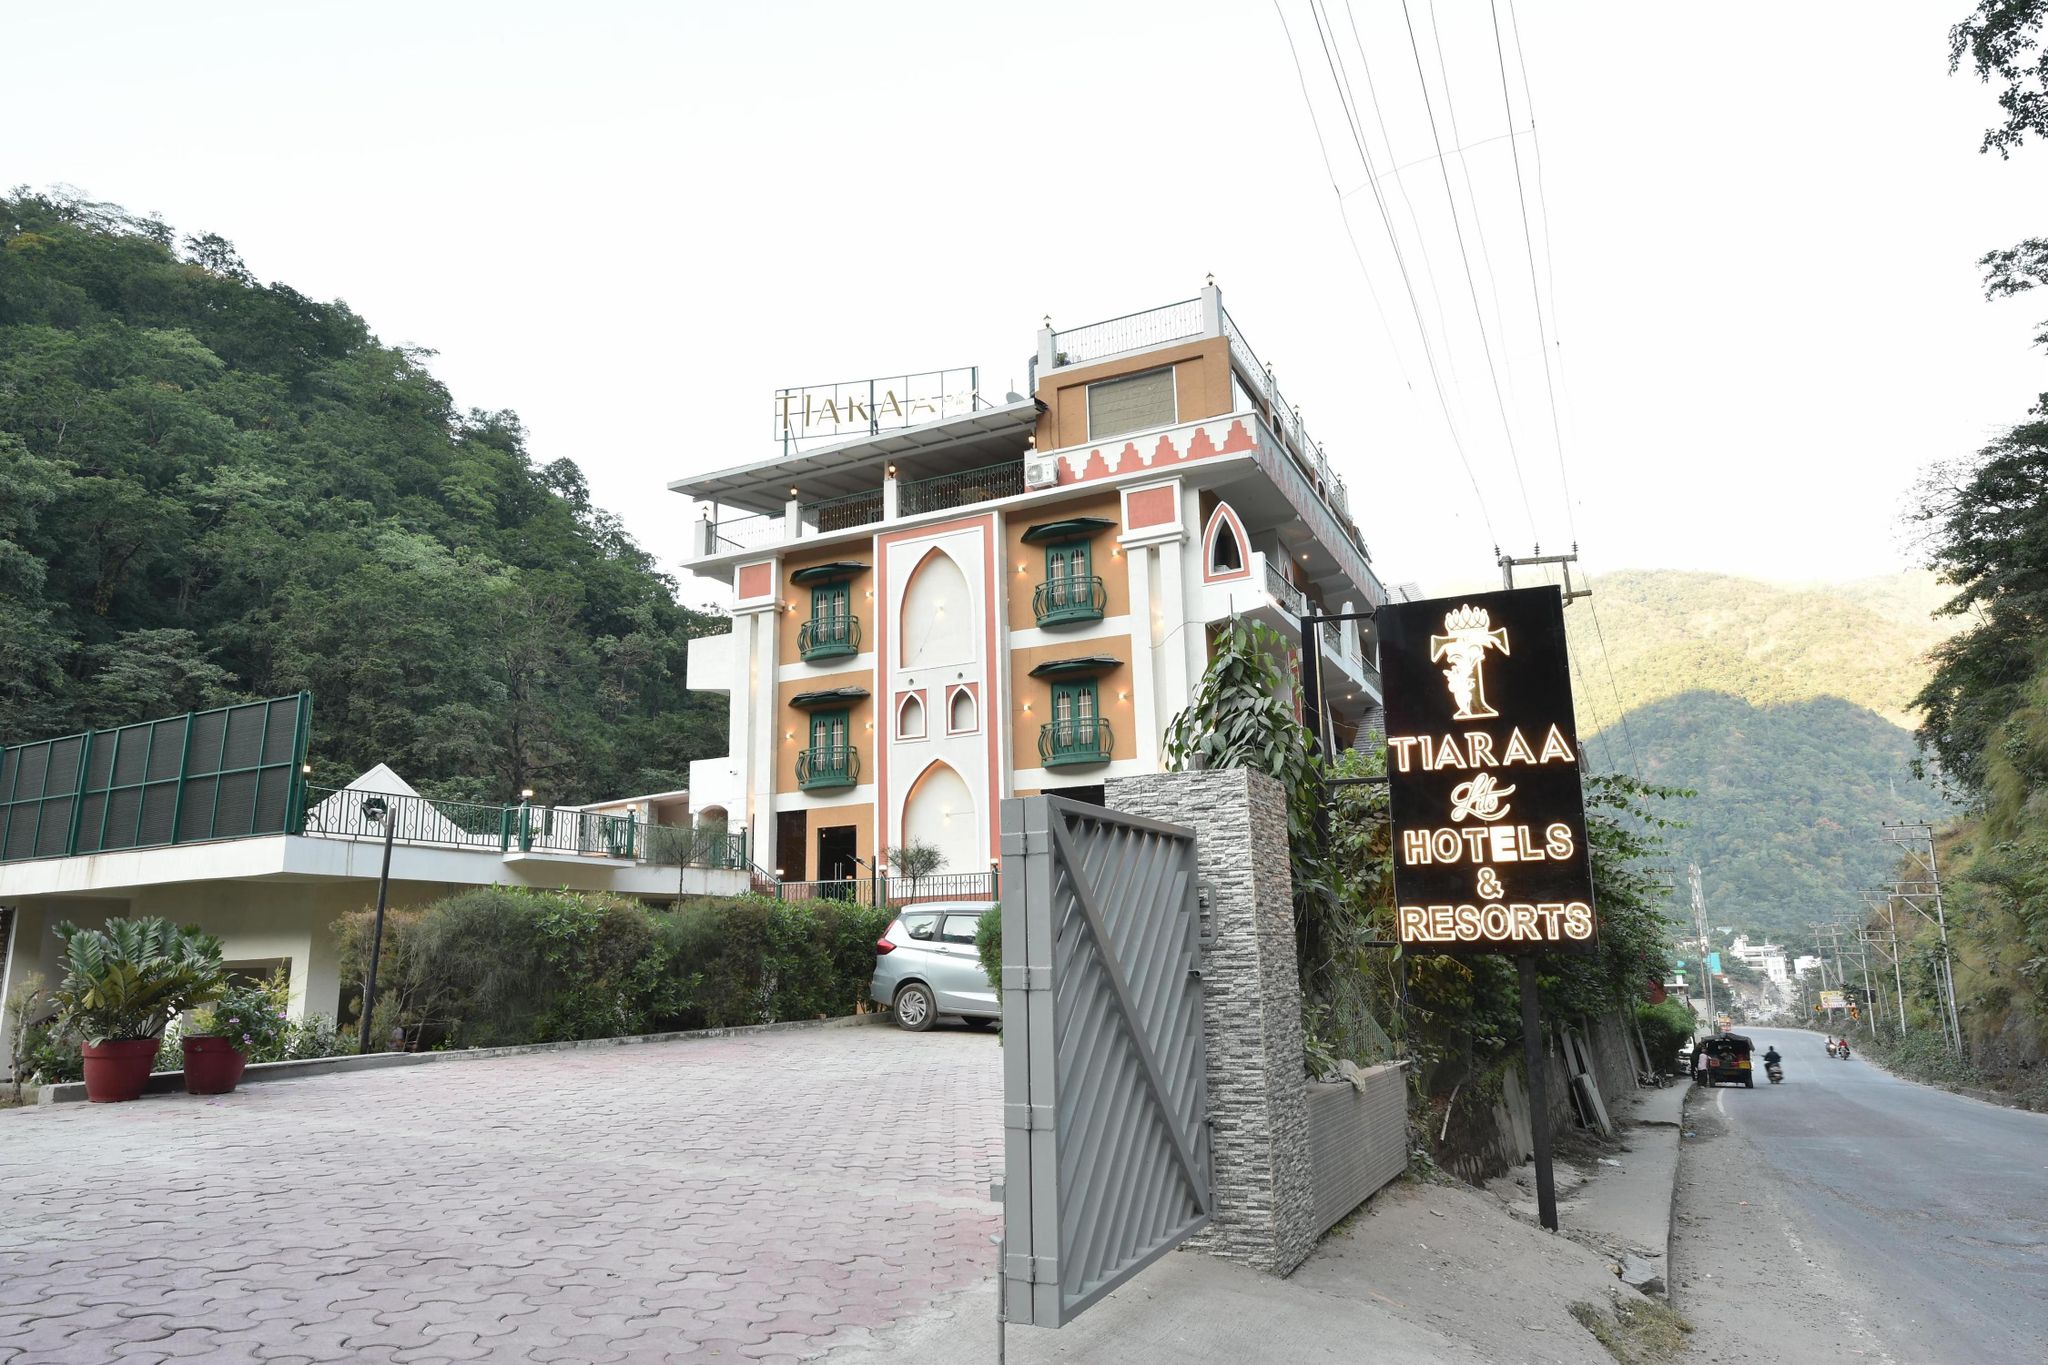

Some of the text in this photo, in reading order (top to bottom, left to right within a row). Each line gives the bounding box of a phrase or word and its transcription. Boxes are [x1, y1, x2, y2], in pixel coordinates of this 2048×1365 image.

[1388, 723, 1575, 772] TIARAA
[1403, 823, 1574, 866] HOTELS
[1476, 867, 1504, 900] &
[1400, 902, 1593, 943] RESORTS
